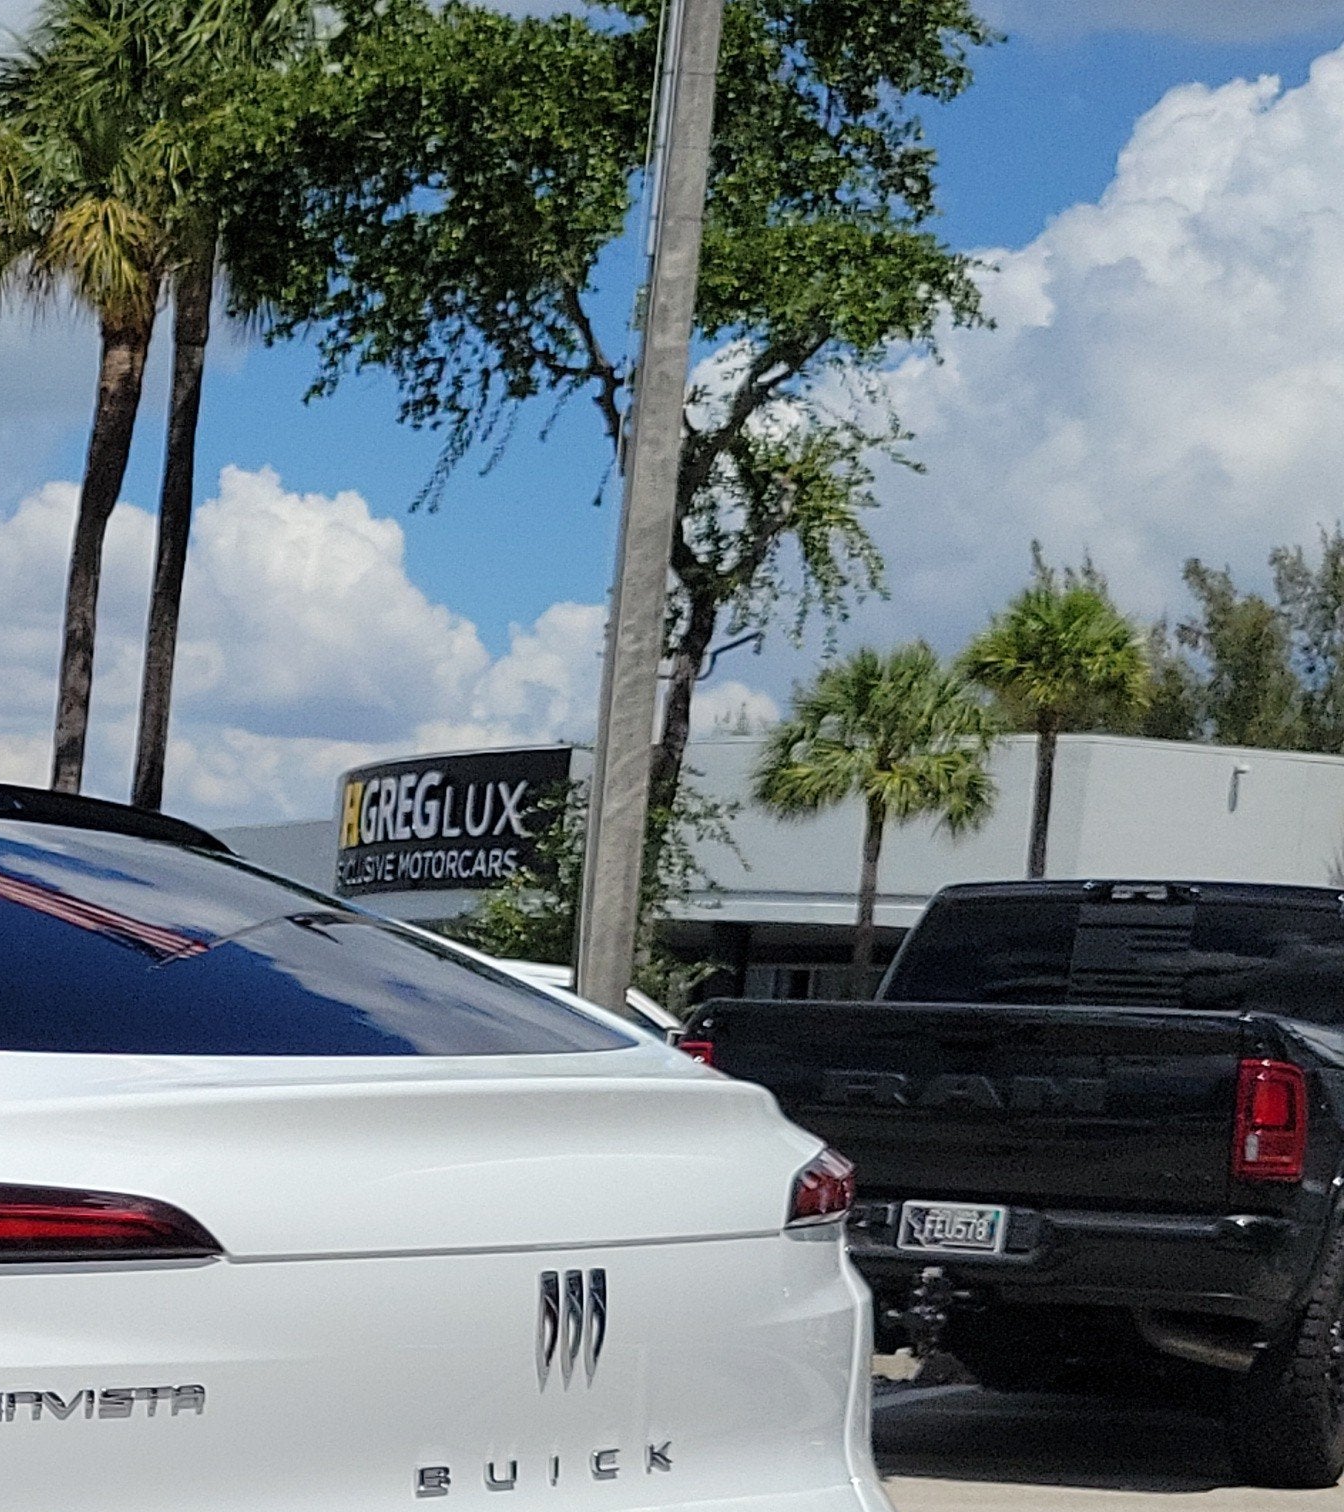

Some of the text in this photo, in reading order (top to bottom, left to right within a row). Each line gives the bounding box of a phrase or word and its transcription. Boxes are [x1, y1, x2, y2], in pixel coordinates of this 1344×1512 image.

[441, 779, 534, 838] LUX
[337, 847, 519, 887] CLUSIVE MOTORCARS
[820, 1070, 1108, 1110] RAM
[414, 1441, 675, 1498] BUICK
